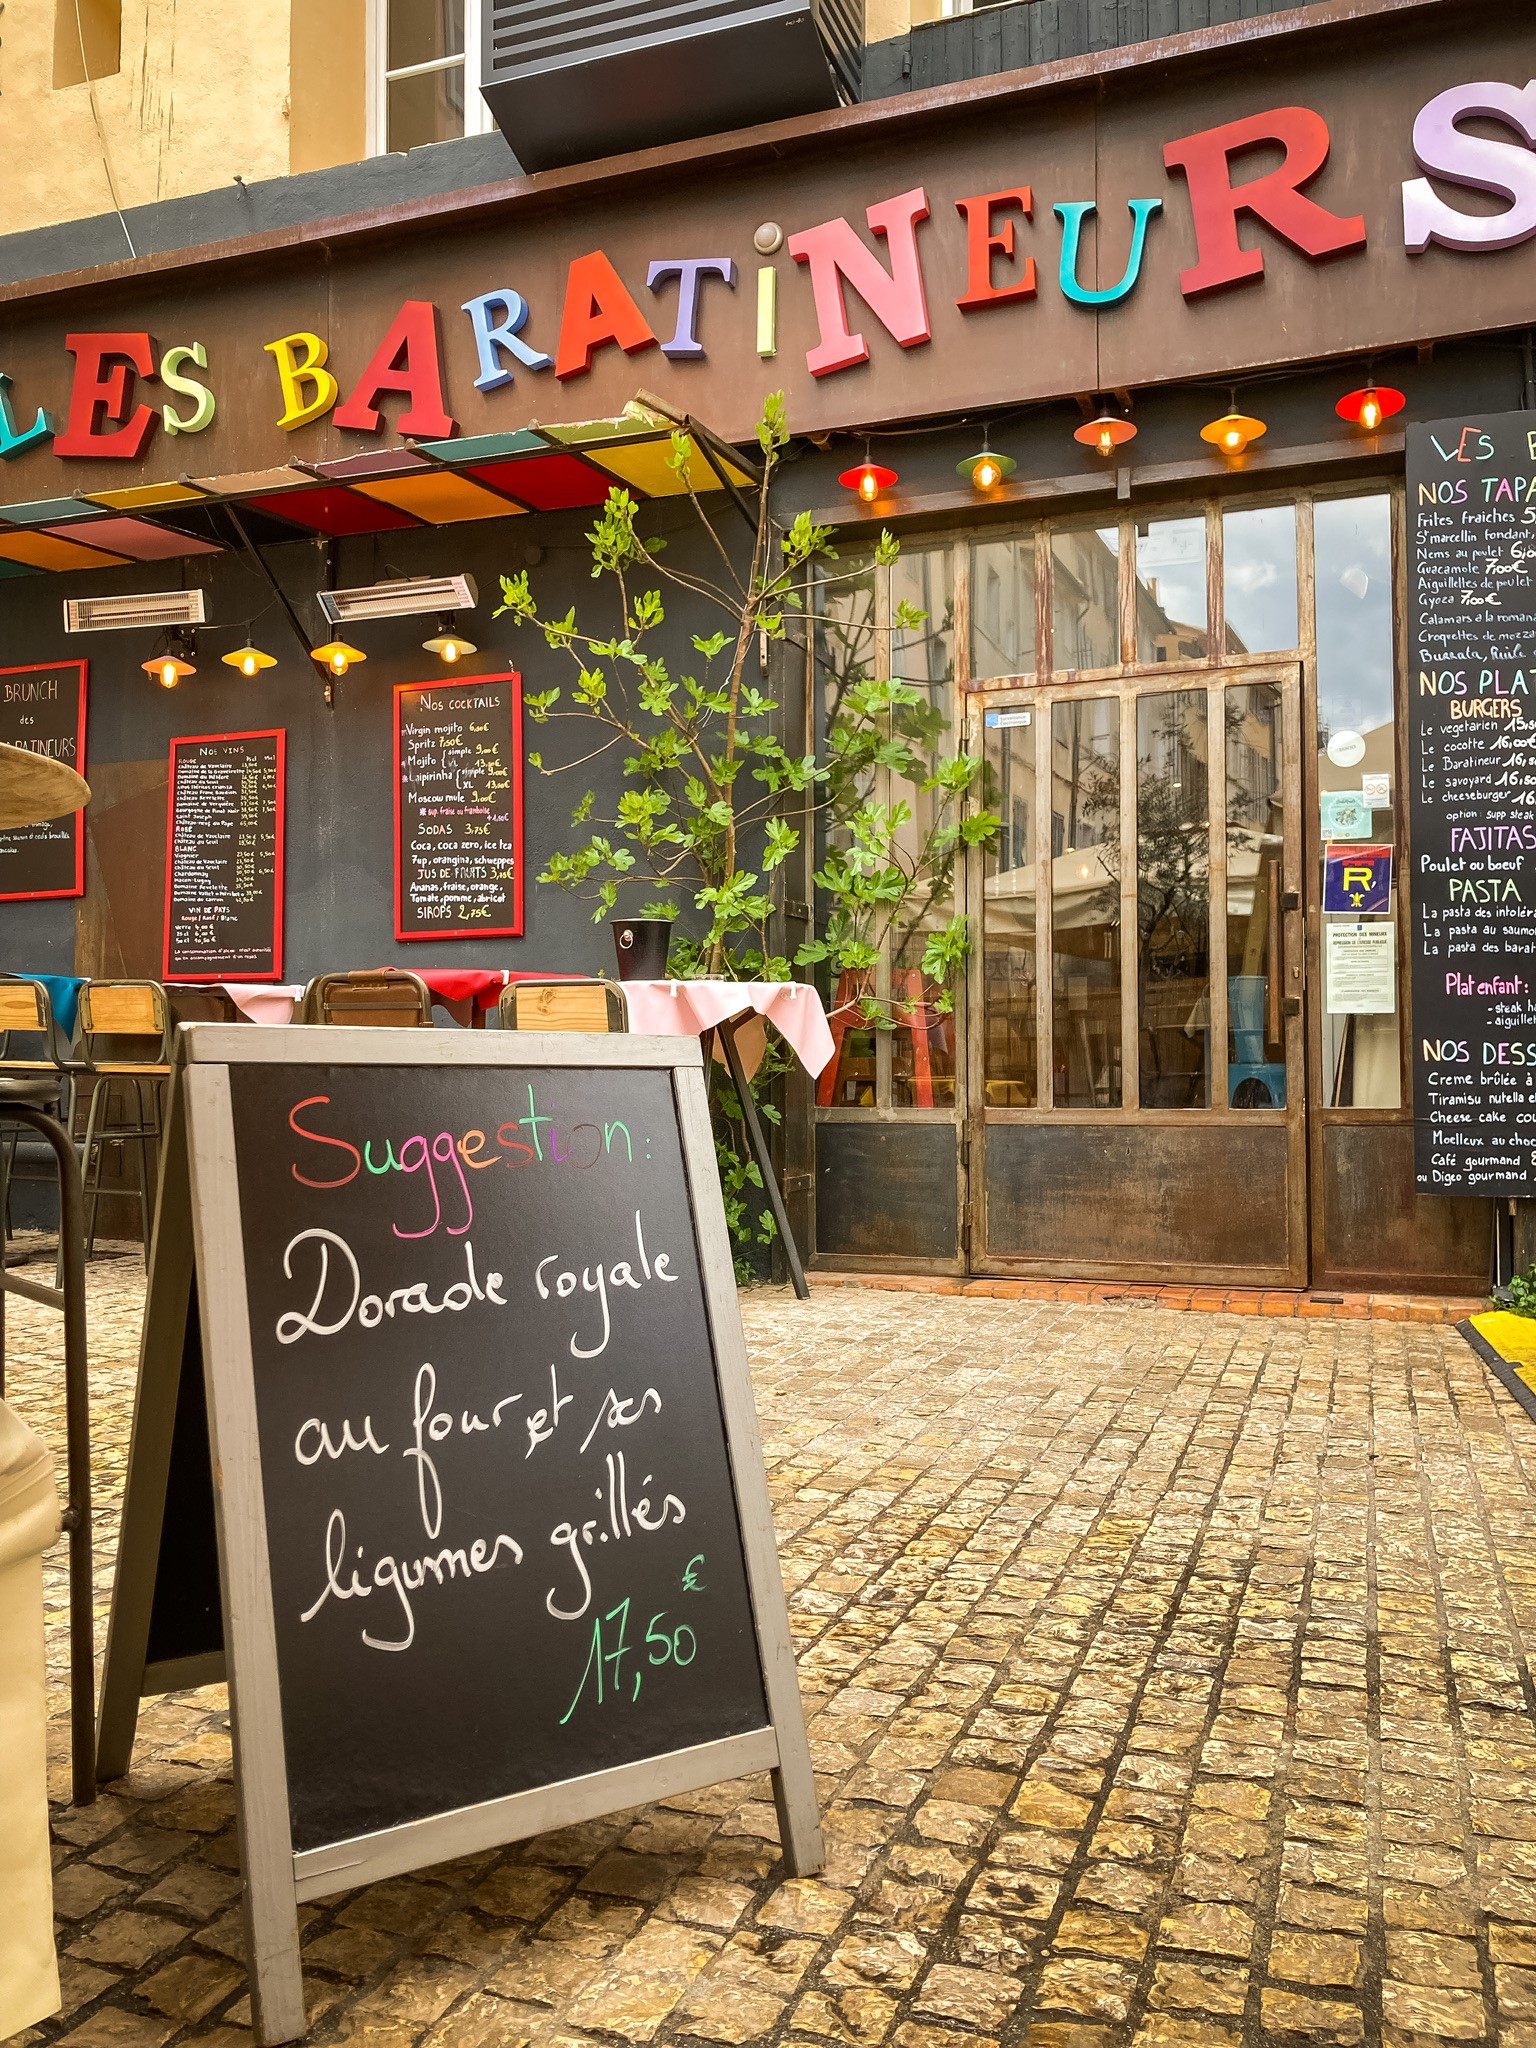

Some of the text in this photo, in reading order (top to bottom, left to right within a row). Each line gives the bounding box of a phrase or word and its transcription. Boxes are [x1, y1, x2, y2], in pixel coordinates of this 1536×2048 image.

[0, 332, 216, 461] LES
[1418, 479, 1468, 506] NOS
[1418, 508, 1515, 527] Frites fraiches
[1417, 545, 1504, 561] Nems au poulet
[1417, 562, 1480, 574] Guacamole
[1418, 575, 1533, 594] Aiguillettes de poulet
[1419, 593, 1454, 609] Gyoza
[1420, 612, 1472, 625] Calamars
[1486, 610, 1493, 622] la
[1418, 630, 1496, 647] Croquettes de
[4, 680, 57, 702] BRUNCH
[1420, 670, 1467, 696] NOS
[449, 697, 500, 709] COCKTAILS
[1450, 698, 1522, 719] BURGERS
[20, 715, 34, 724] des
[406, 723, 431, 737] Virgin
[434, 722, 463, 735] mojito
[1421, 720, 1497, 738] Le vegetarien
[408, 738, 435, 754] Spritz
[1421, 740, 1434, 755] Le
[1444, 738, 1485, 752] cocotte
[408, 754, 436, 768] Mojito
[448, 747, 472, 758] simple
[1422, 756, 1501, 772] Le Baratineur
[463, 781, 474, 789] XL
[1422, 774, 1491, 788] Le savoyard
[408, 792, 443, 804] Moscow
[445, 791, 465, 802] mule
[1422, 790, 1511, 803] Le cheeseburger
[440, 807, 455, 815] fraise
[464, 806, 490, 815] framboise
[1510, 809, 1534, 820] steak
[438, 842, 458, 850] coca
[484, 840, 496, 850] ice
[499, 839, 512, 850] tea
[1451, 825, 1536, 852] FAJITAS
[474, 855, 514, 869] schweppes
[1421, 855, 1466, 873] Poulet
[1469, 862, 1484, 870] ou
[417, 869, 437, 880] JUS
[440, 868, 451, 878] DE
[477, 893, 506, 903] abricot
[1449, 878, 1522, 903] PASTA
[417, 906, 452, 919] SIROPS
[1423, 903, 1491, 921] La pasta des
[1424, 922, 1496, 940] La pasta au
[1424, 941, 1438, 955] La
[1448, 942, 1475, 958] pasta
[1482, 942, 1499, 952] des
[1446, 972, 1475, 995] Plat
[1423, 1039, 1469, 1062] NOS
[1428, 1071, 1532, 1086] Creme brûlée à
[1428, 1092, 1524, 1105] Tiramisu nutella
[1430, 1111, 1506, 1123] Cheese cake
[1433, 1130, 1484, 1146] Moelleux
[1431, 1153, 1520, 1171] Café gourmand
[1468, 1170, 1527, 1185] gourmand
[275, 1209, 680, 1359] Dorade royale
[294, 1362, 663, 1540] au four et ses
[545, 1450, 687, 1621] grillés
[559, 1596, 698, 1726] 17,50
